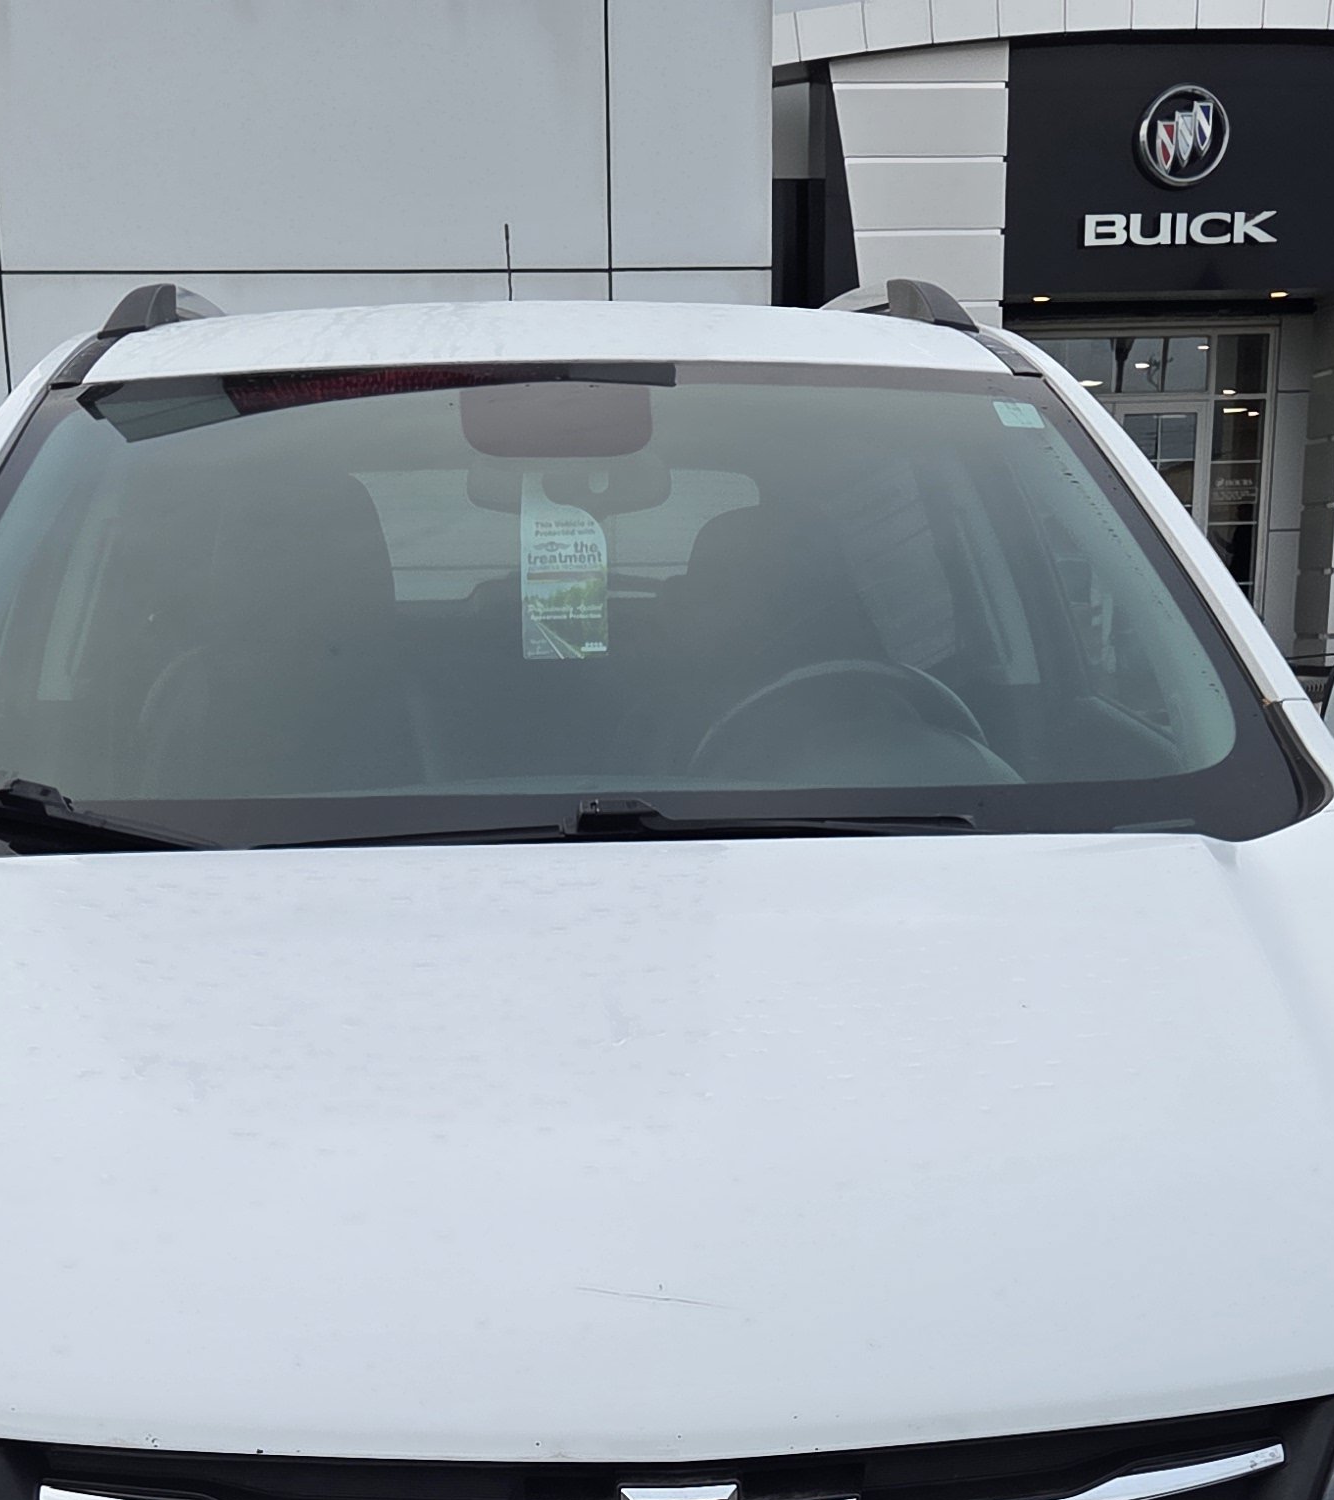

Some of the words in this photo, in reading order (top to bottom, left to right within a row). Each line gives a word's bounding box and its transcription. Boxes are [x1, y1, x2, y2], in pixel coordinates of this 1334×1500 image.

[1084, 210, 1278, 247] BUICK
[573, 541, 599, 553] the
[527, 551, 602, 565] treatment
